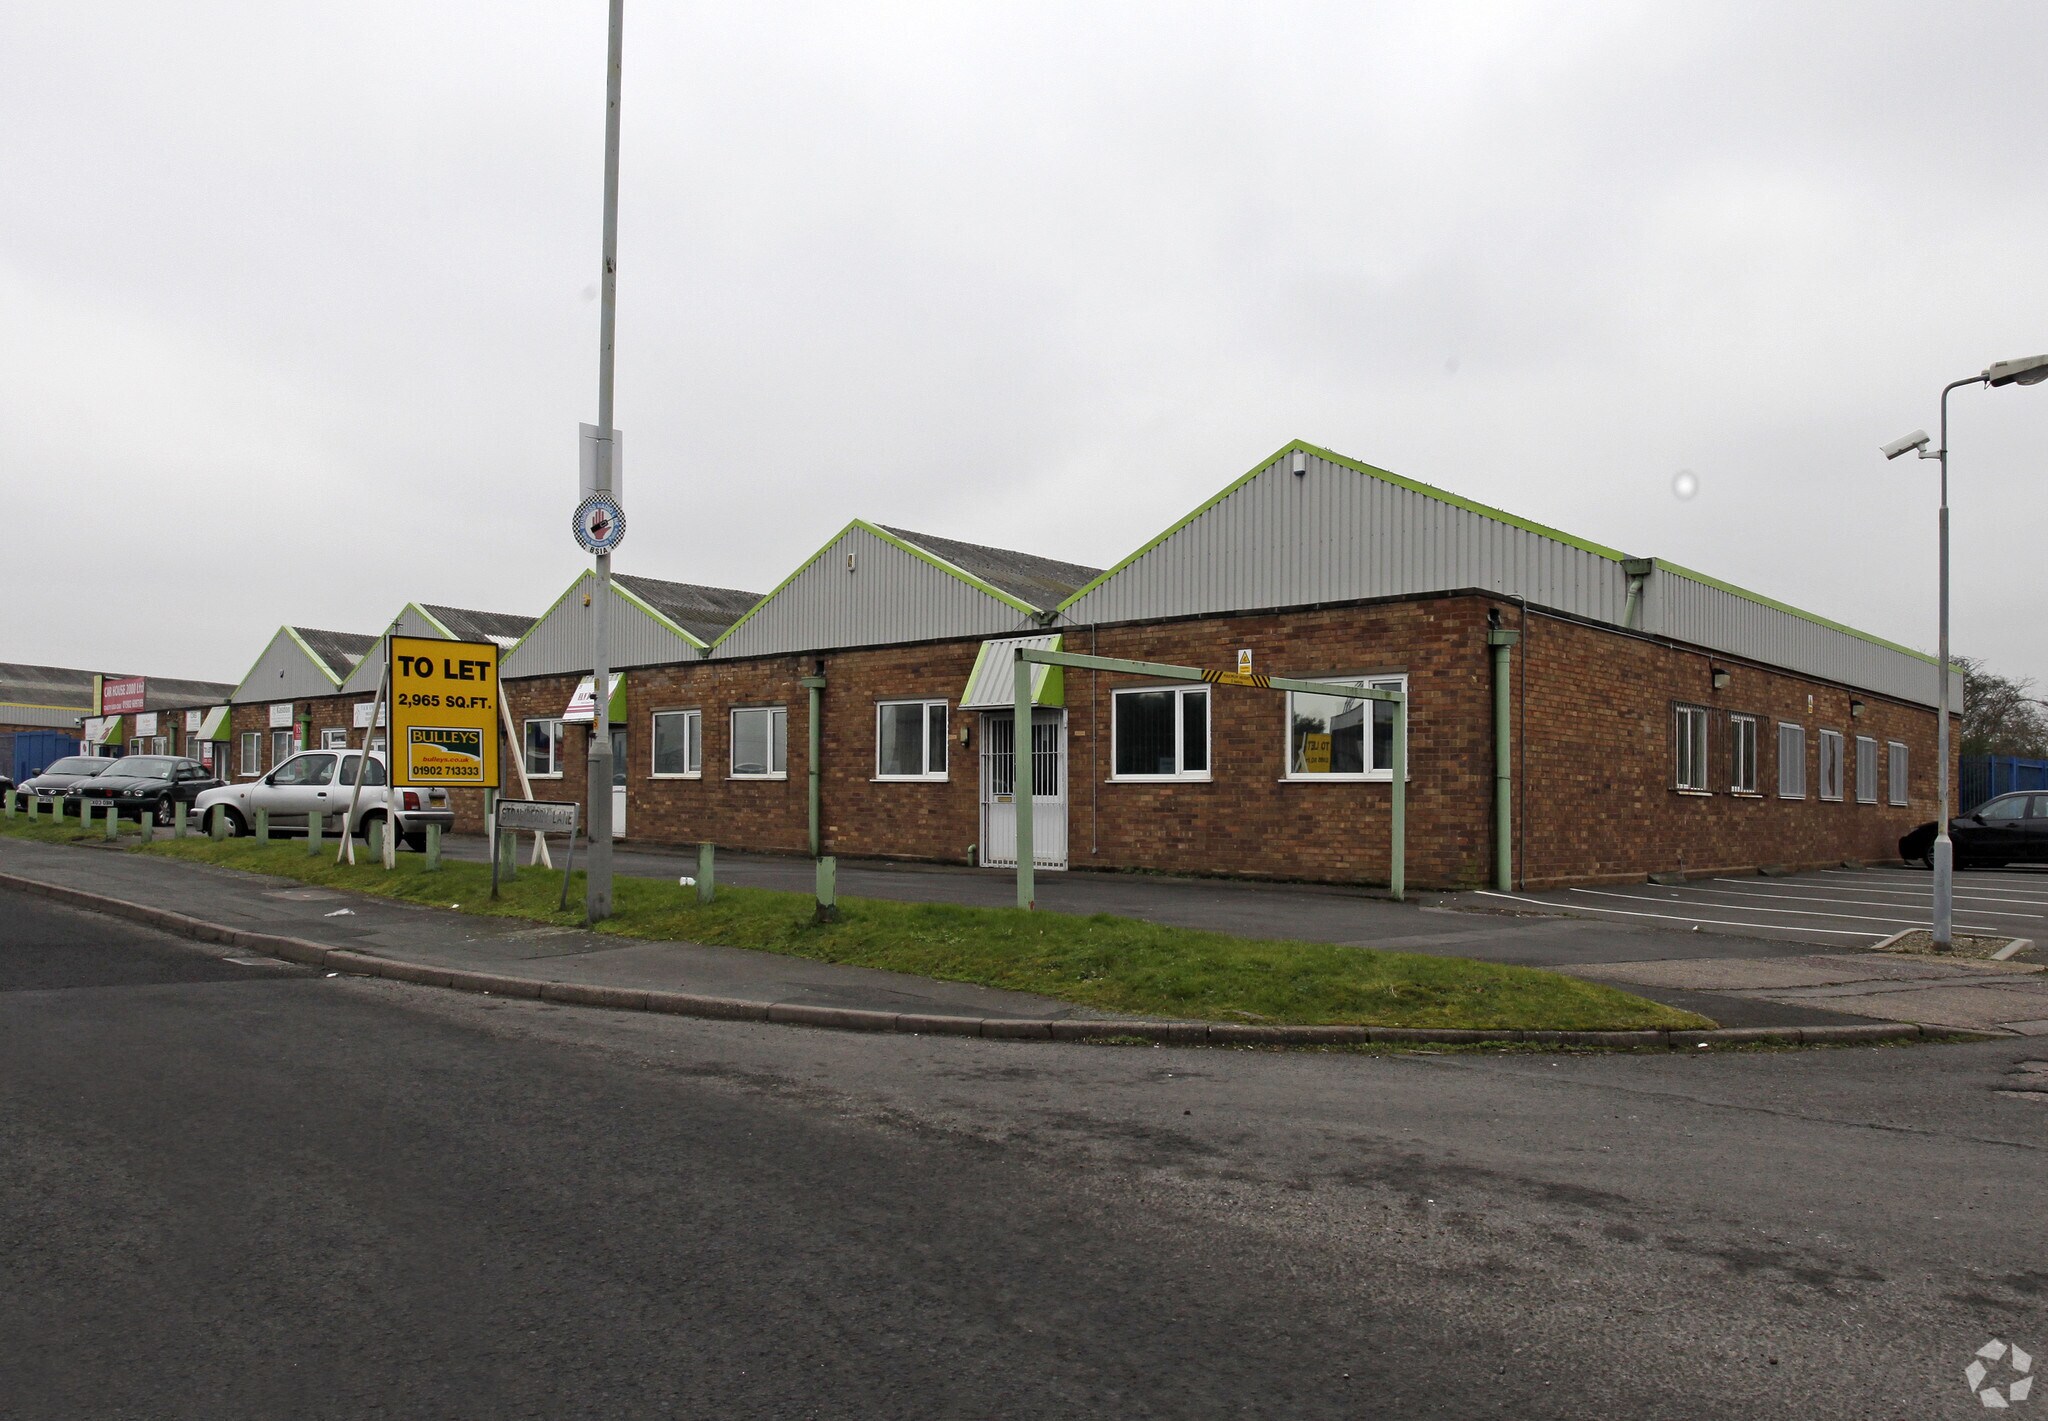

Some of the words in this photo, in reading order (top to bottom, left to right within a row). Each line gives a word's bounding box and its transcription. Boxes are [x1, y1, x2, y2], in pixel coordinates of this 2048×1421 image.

[589, 546, 608, 555] BSIA
[398, 656, 434, 678] TO
[444, 659, 491, 681] LET
[398, 693, 440, 708] 2,965
[445, 695, 492, 709] SQ.FT.
[412, 730, 479, 744] BULLEYS
[413, 766, 443, 776] 01902
[445, 766, 479, 776] 713333
[552, 810, 574, 825] LANE
